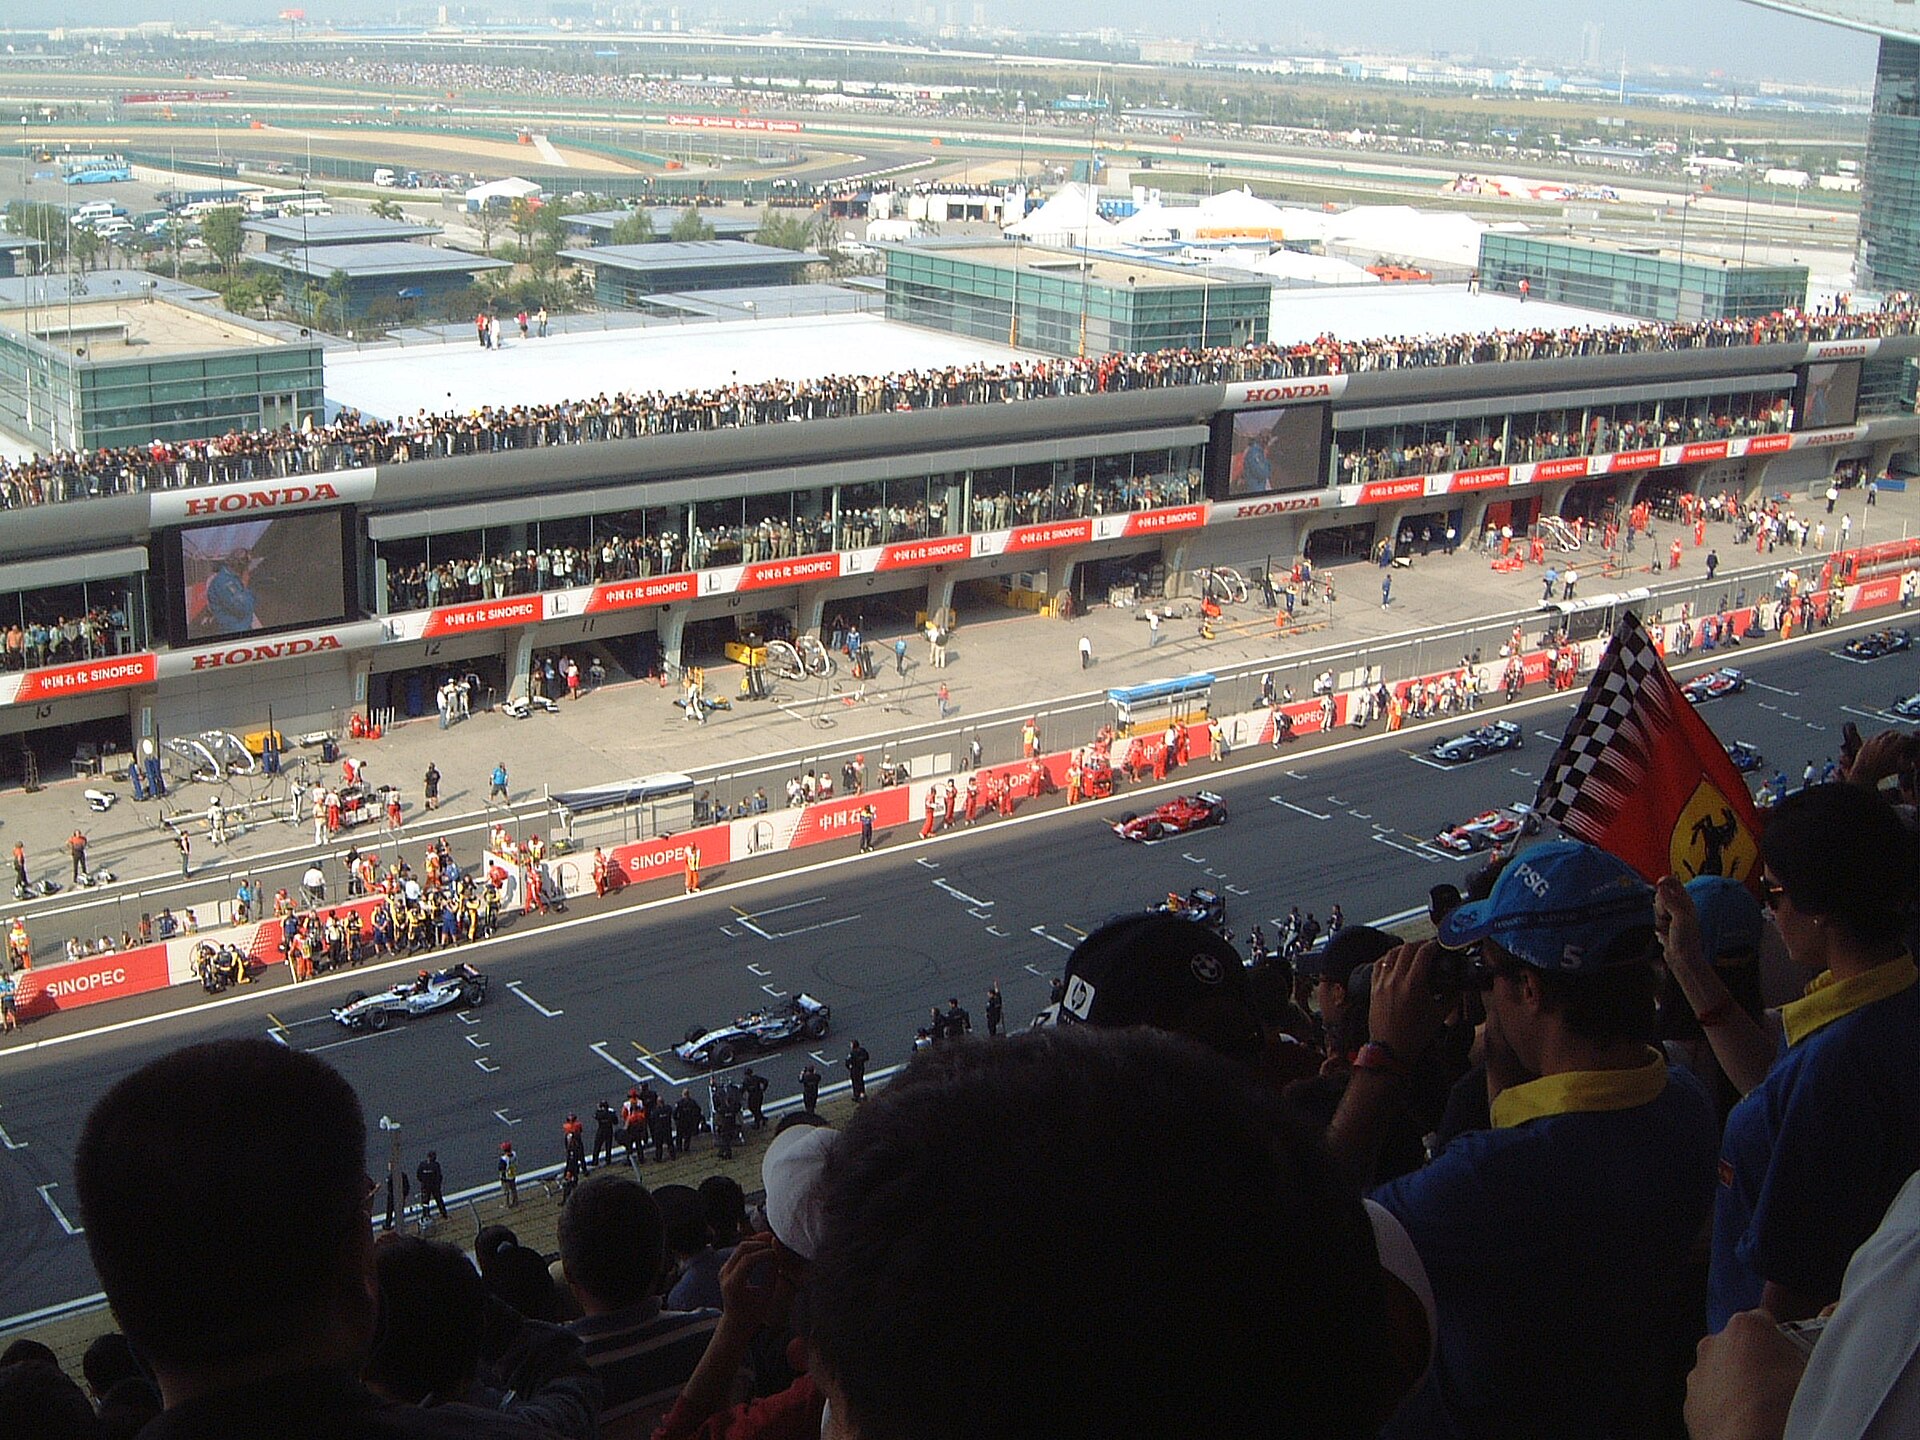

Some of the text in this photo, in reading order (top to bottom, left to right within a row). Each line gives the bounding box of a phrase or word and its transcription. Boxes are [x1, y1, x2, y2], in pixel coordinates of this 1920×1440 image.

[1244, 384, 1331, 403] HONDA
[184, 482, 340, 517] HONDA
[1234, 497, 1320, 518] HONDA
[927, 542, 964, 557] SINOPEC
[793, 560, 832, 576] SINOPEC
[646, 580, 689, 597] SINOPEC
[488, 603, 534, 621] SINOPEC
[191, 635, 343, 671] HONDA
[424, 642, 441, 657] 12
[91, 662, 144, 682] SINOPEC
[36, 704, 53, 720] 13
[1291, 710, 1324, 727] NOPEC
[630, 846, 686, 871] SINOPE
[1513, 862, 1550, 899] PSG
[46, 968, 126, 998] SINOPEC
